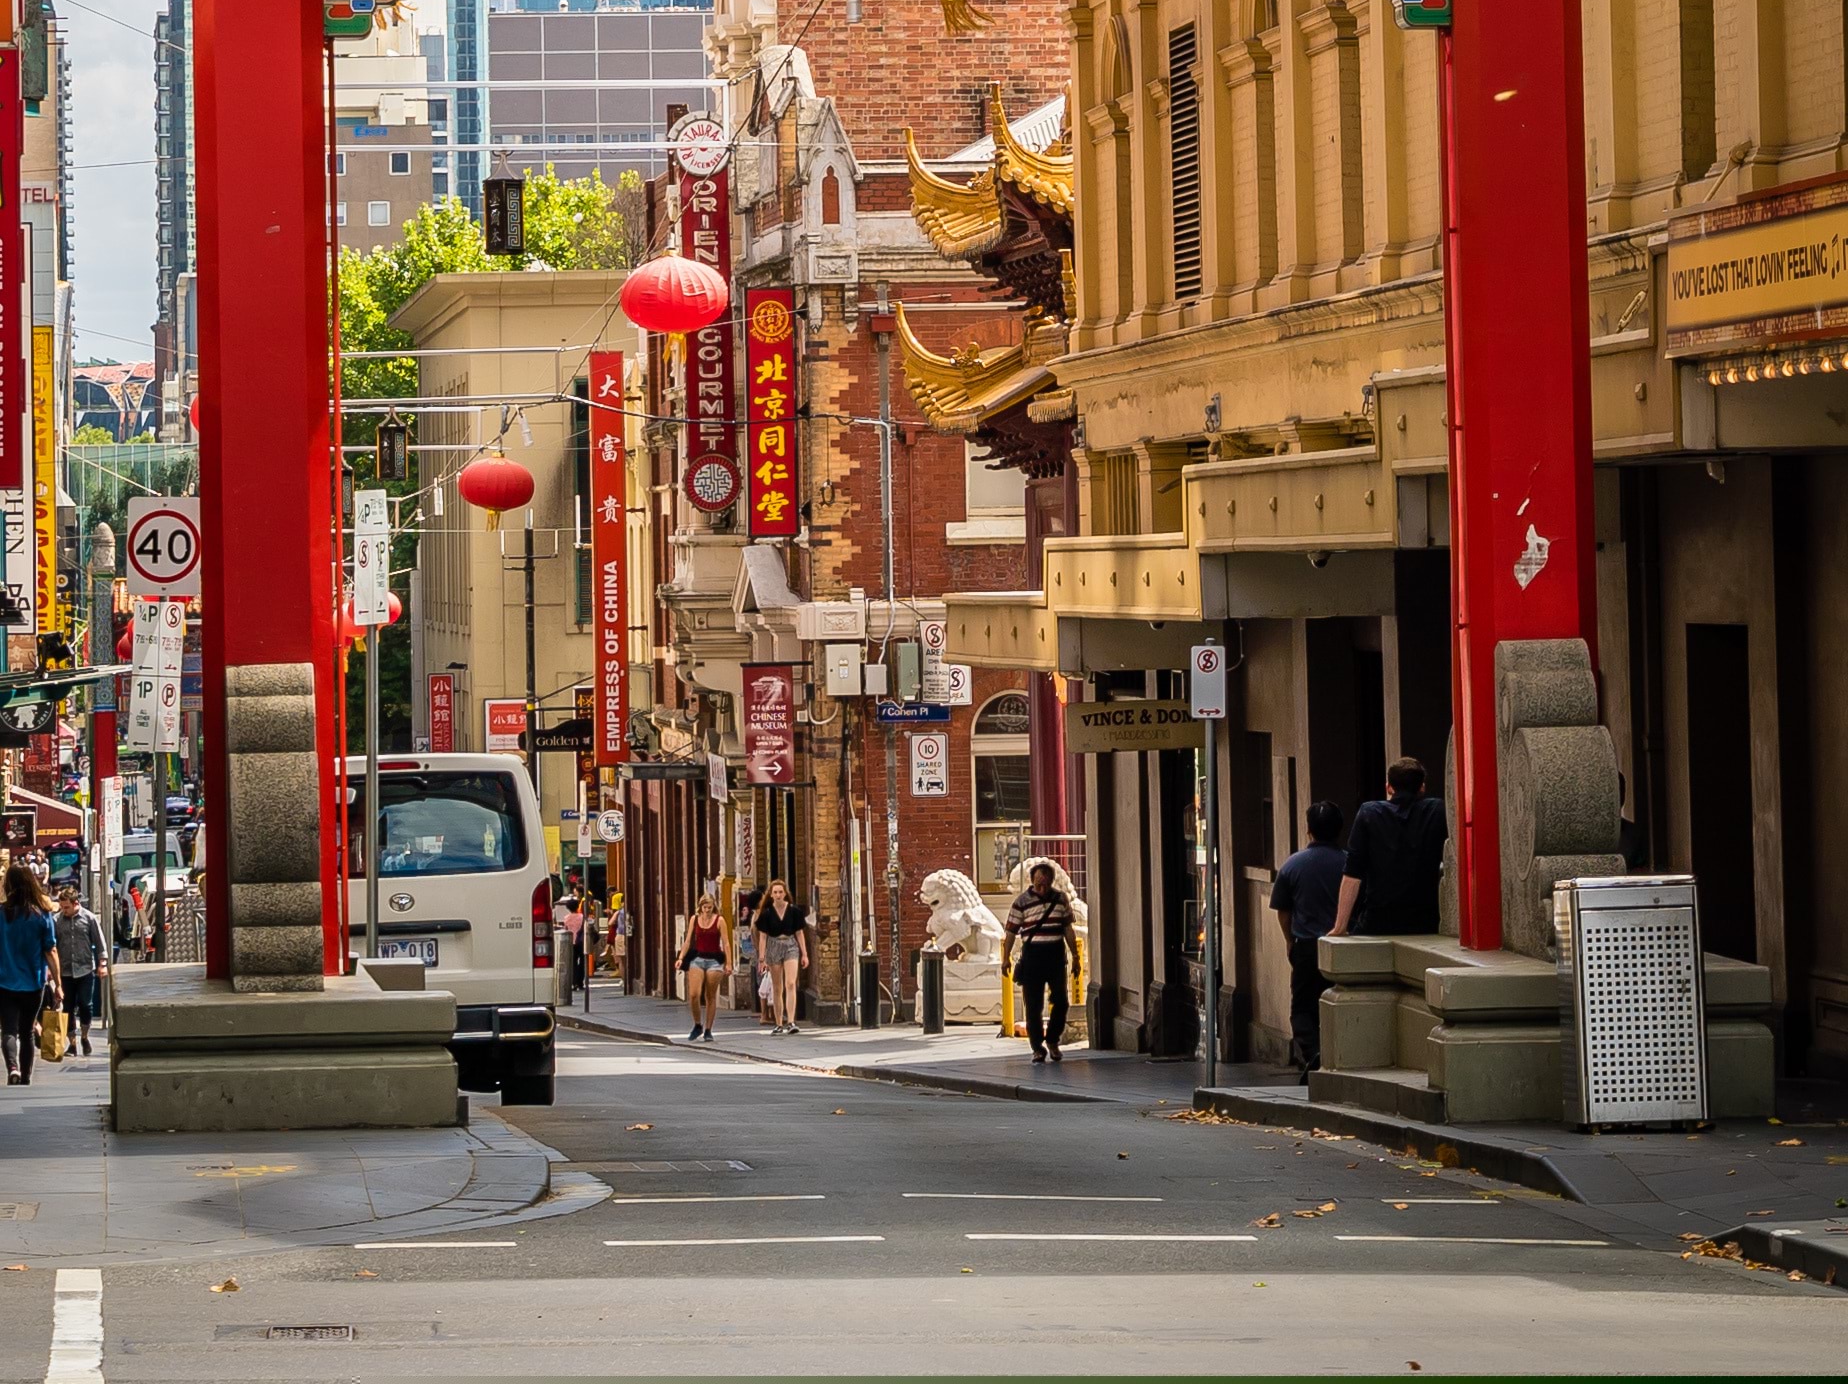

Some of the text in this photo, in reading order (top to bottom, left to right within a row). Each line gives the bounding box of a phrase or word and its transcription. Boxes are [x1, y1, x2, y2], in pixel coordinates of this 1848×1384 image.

[681, 124, 725, 160] RTAURA
[691, 153, 722, 169] LICENSED
[693, 180, 719, 270] ORIEN
[1672, 237, 1848, 300] YOU'VE LOST THAT LOVIN' FEELING I
[697, 328, 725, 451] GOURMET
[754, 353, 790, 522] 北京同仁堂
[136, 529, 192, 564] 40
[603, 560, 621, 752] EMPRESS OF CHINA
[137, 681, 153, 698] 1P
[949, 692, 964, 700] REA
[751, 713, 787, 721] CHINESE
[887, 707, 917, 716] Cohen
[1082, 709, 1135, 727] VINCE
[1140, 708, 1152, 725] &
[751, 722, 788, 730] MUSEUM
[536, 735, 579, 746] Golden
[924, 744, 934, 754] 10
[379, 943, 434, 958] WP 018
